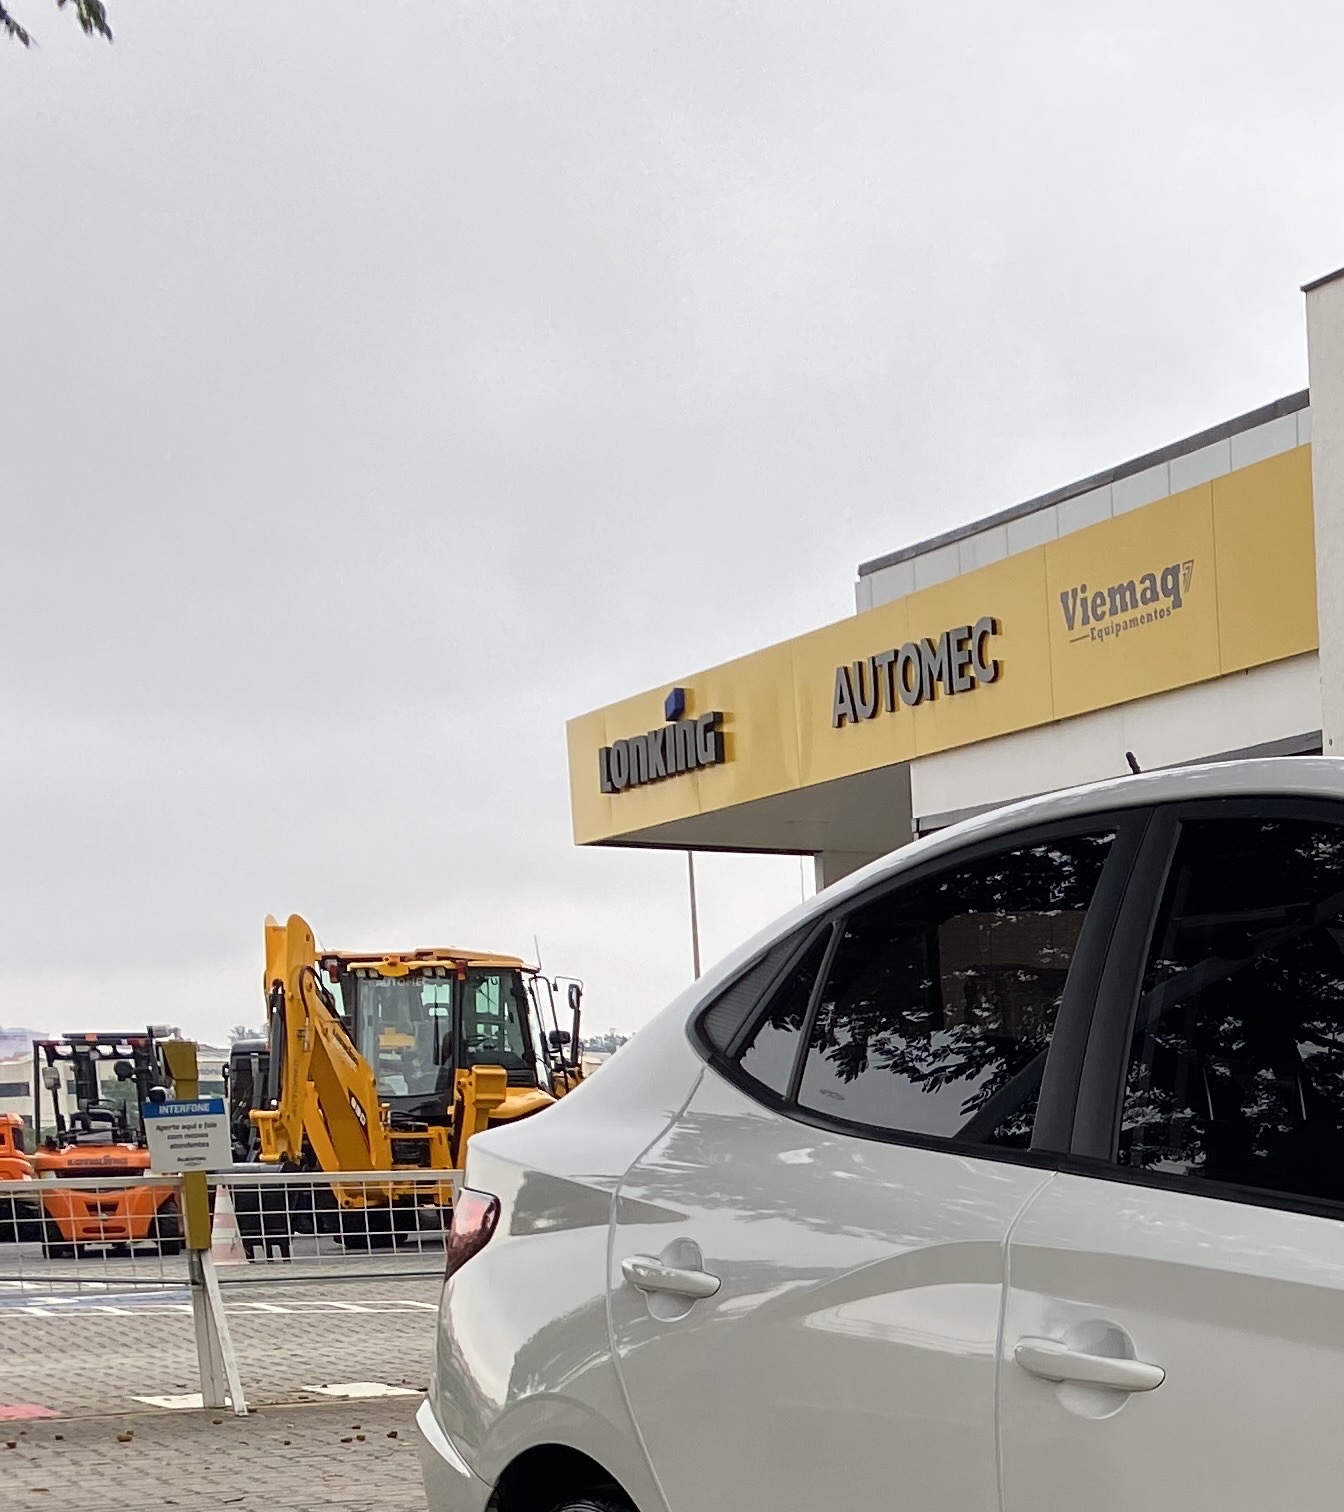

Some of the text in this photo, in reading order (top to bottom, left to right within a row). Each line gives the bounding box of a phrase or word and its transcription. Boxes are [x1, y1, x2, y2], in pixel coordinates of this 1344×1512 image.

[1060, 562, 1184, 632] Viemaq
[1090, 605, 1172, 642] Equipamentos
[832, 616, 1004, 729] AUTOMEC
[158, 1102, 211, 1114] INTERFONE
